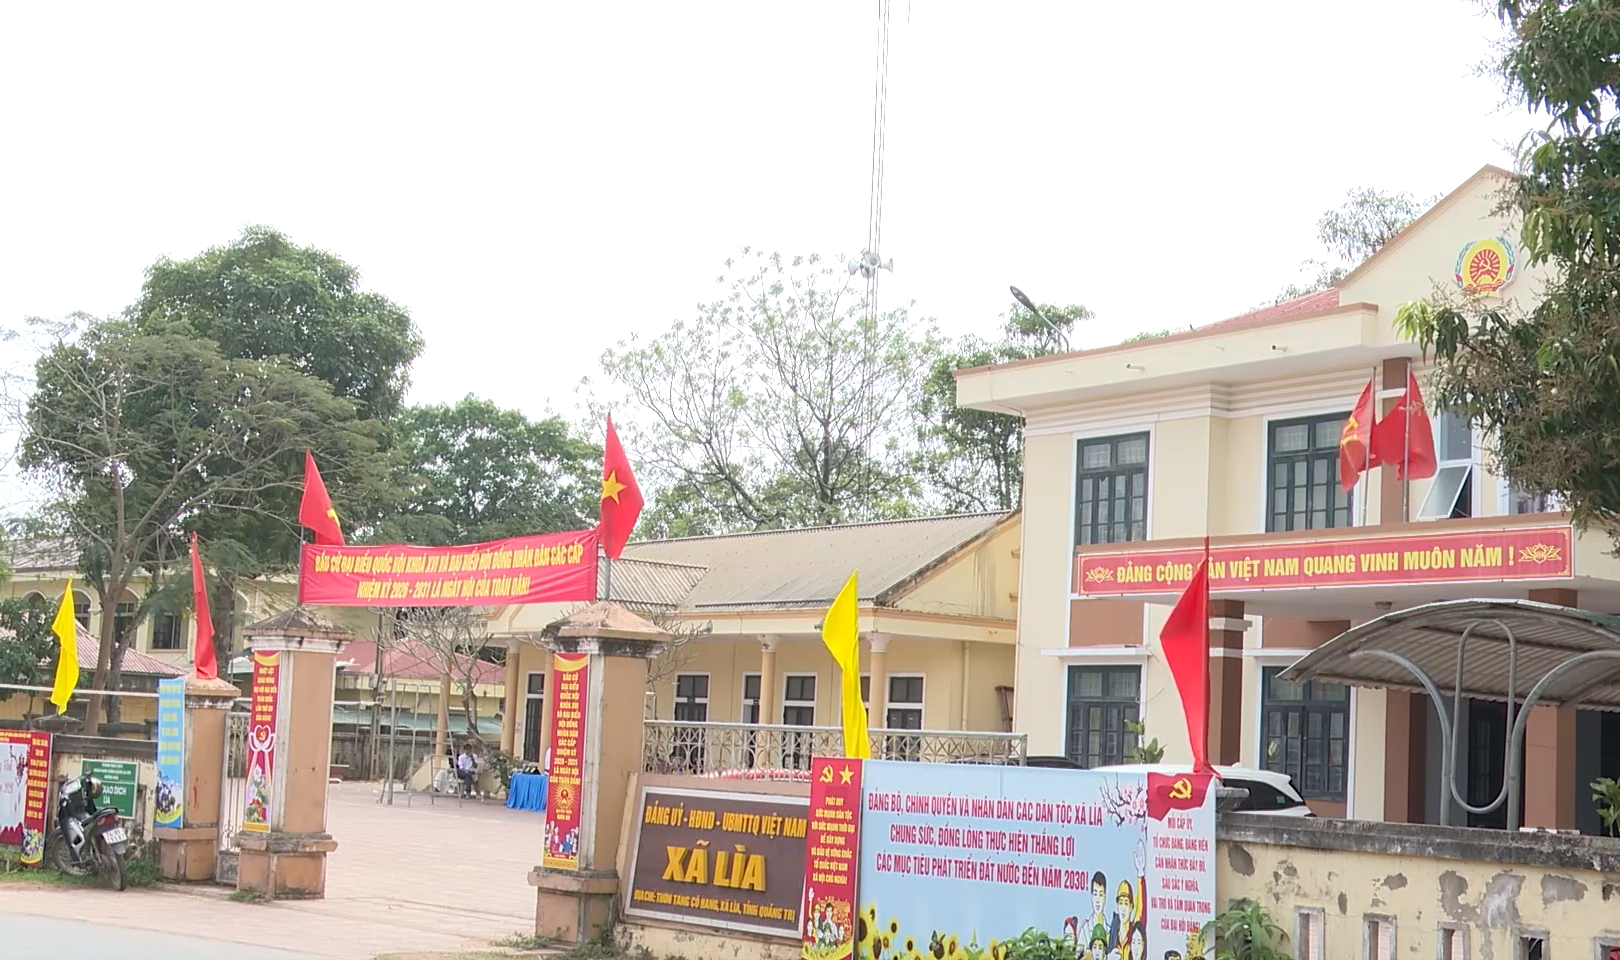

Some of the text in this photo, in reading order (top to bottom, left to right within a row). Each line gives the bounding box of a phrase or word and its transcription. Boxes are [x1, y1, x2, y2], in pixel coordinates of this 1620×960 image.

[1117, 561, 1152, 583] ĐẢNG
[1156, 562, 1192, 585] CỘNG
[1230, 557, 1260, 581] VIỆT
[1264, 558, 1299, 577] NAM
[1304, 555, 1356, 576] QUANG
[1360, 552, 1398, 572] VINH
[1404, 546, 1455, 571] MUÔN
[1460, 544, 1502, 568] NĂM
[1508, 546, 1514, 566] !
[645, 800, 670, 825] ĐẢNG
[671, 802, 684, 826] UỶ
[688, 810, 715, 829] HĐND
[722, 812, 760, 836] UBMTTQ
[761, 812, 782, 839] VIỆT
[783, 818, 807, 838] NAM
[869, 787, 1102, 828] ĐẢNG BỘ, CHÍNH QUYỀN VÀ NHÂN DÂN CÁC DÂN TỘC XÃ LÌA
[890, 821, 1074, 861] CHUNG SỨC, ĐỒNG LÒNG THỰC HIỆN THẮNG LỢI
[662, 840, 766, 891] XÃ LÌA
[877, 850, 1089, 891] CÁC MỤC TIÊU PHÁT TRIỂN ĐẤT NƯỚC ĐẾN NĂM 2030!
